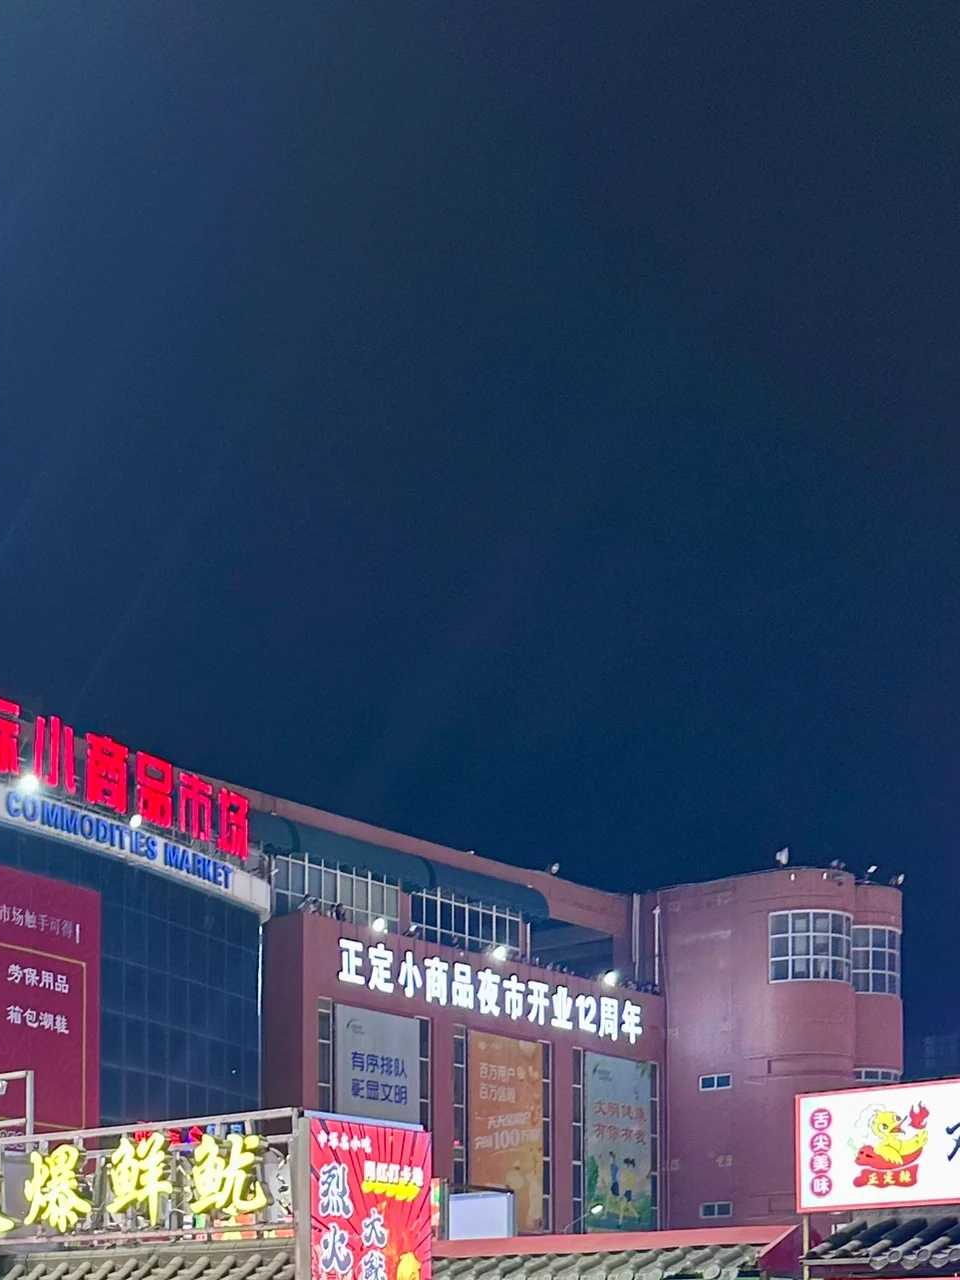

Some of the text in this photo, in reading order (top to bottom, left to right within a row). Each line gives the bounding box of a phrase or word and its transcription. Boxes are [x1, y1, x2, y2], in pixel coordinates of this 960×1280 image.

[6, 789, 158, 861] COMMODITIES
[164, 842, 234, 890] MARKET
[7, 963, 70, 994] 劳保用品
[338, 938, 643, 1045] 正定小商品夜市开业12周年
[6, 1005, 70, 1035] 箱包潮鞋
[351, 1051, 408, 1079] 有序排队
[351, 1078, 408, 1105] 彰显文明
[812, 1111, 831, 1195] 舌尖美味
[319, 1162, 353, 1275] 烈火
